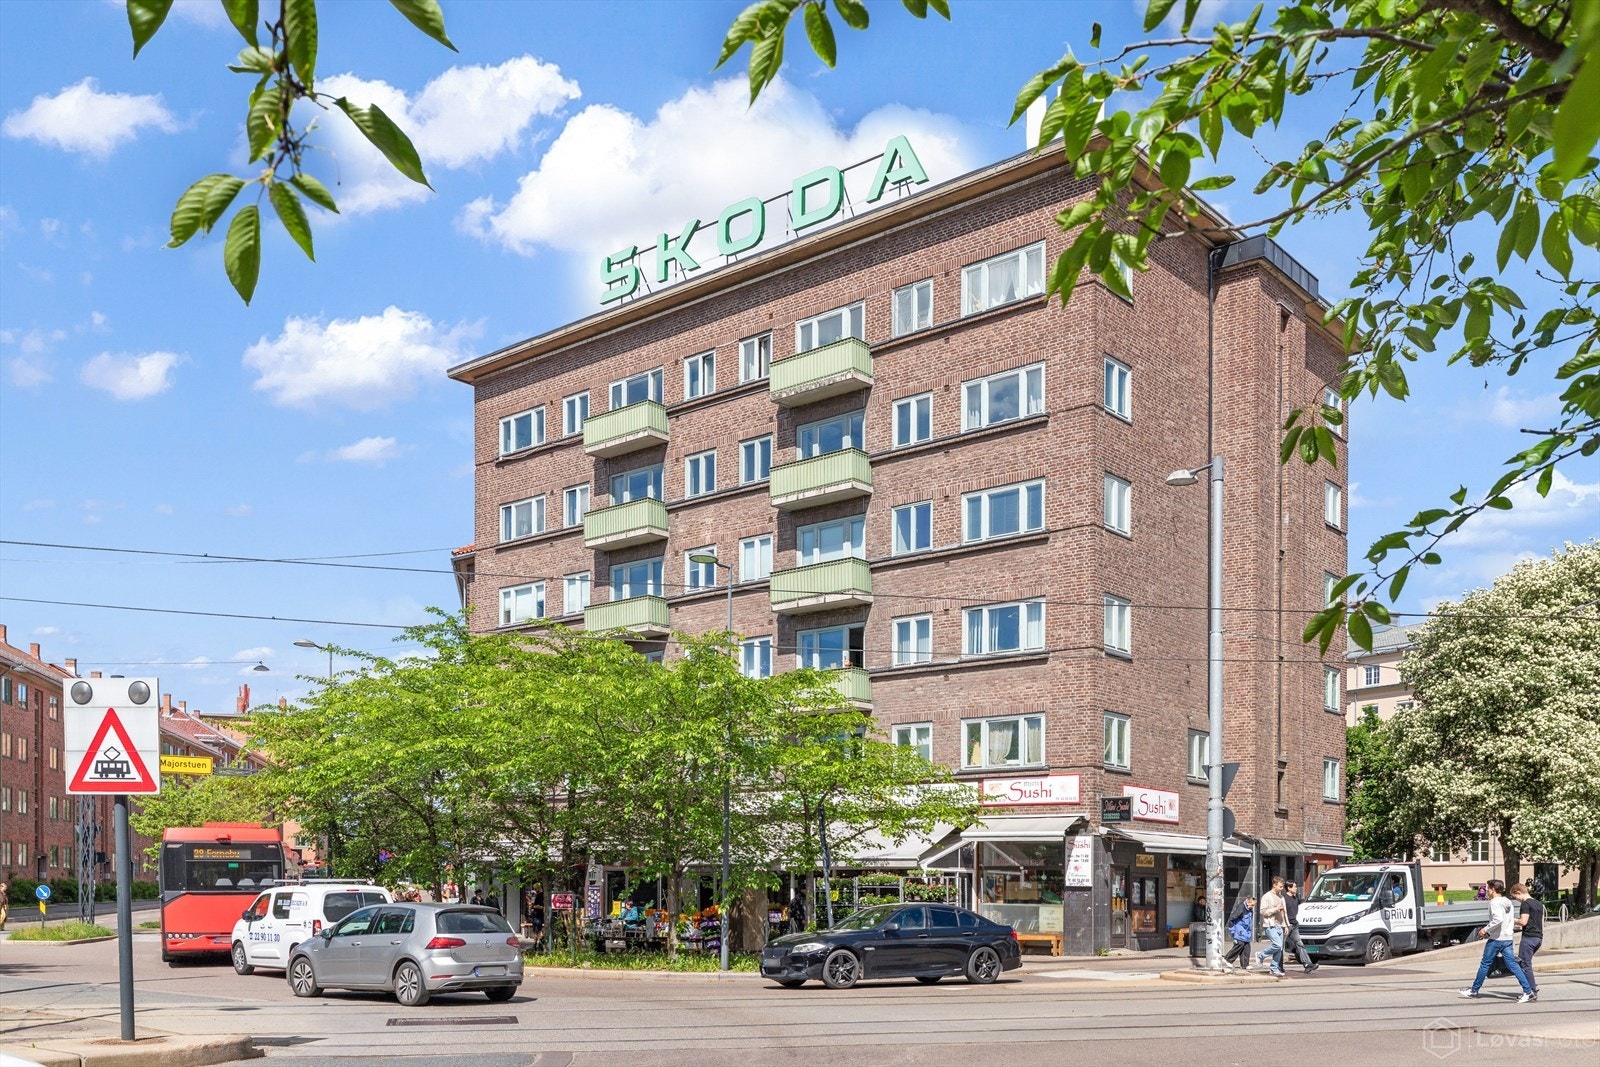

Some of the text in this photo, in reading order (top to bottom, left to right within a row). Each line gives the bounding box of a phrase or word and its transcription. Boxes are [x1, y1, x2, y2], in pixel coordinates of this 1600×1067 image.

[600, 135, 929, 305] SKODA
[160, 759, 207, 769] Majorstuen
[1008, 781, 1052, 801] Sushi
[1138, 793, 1166, 816] Sushi
[1067, 839, 1090, 850] Sushi
